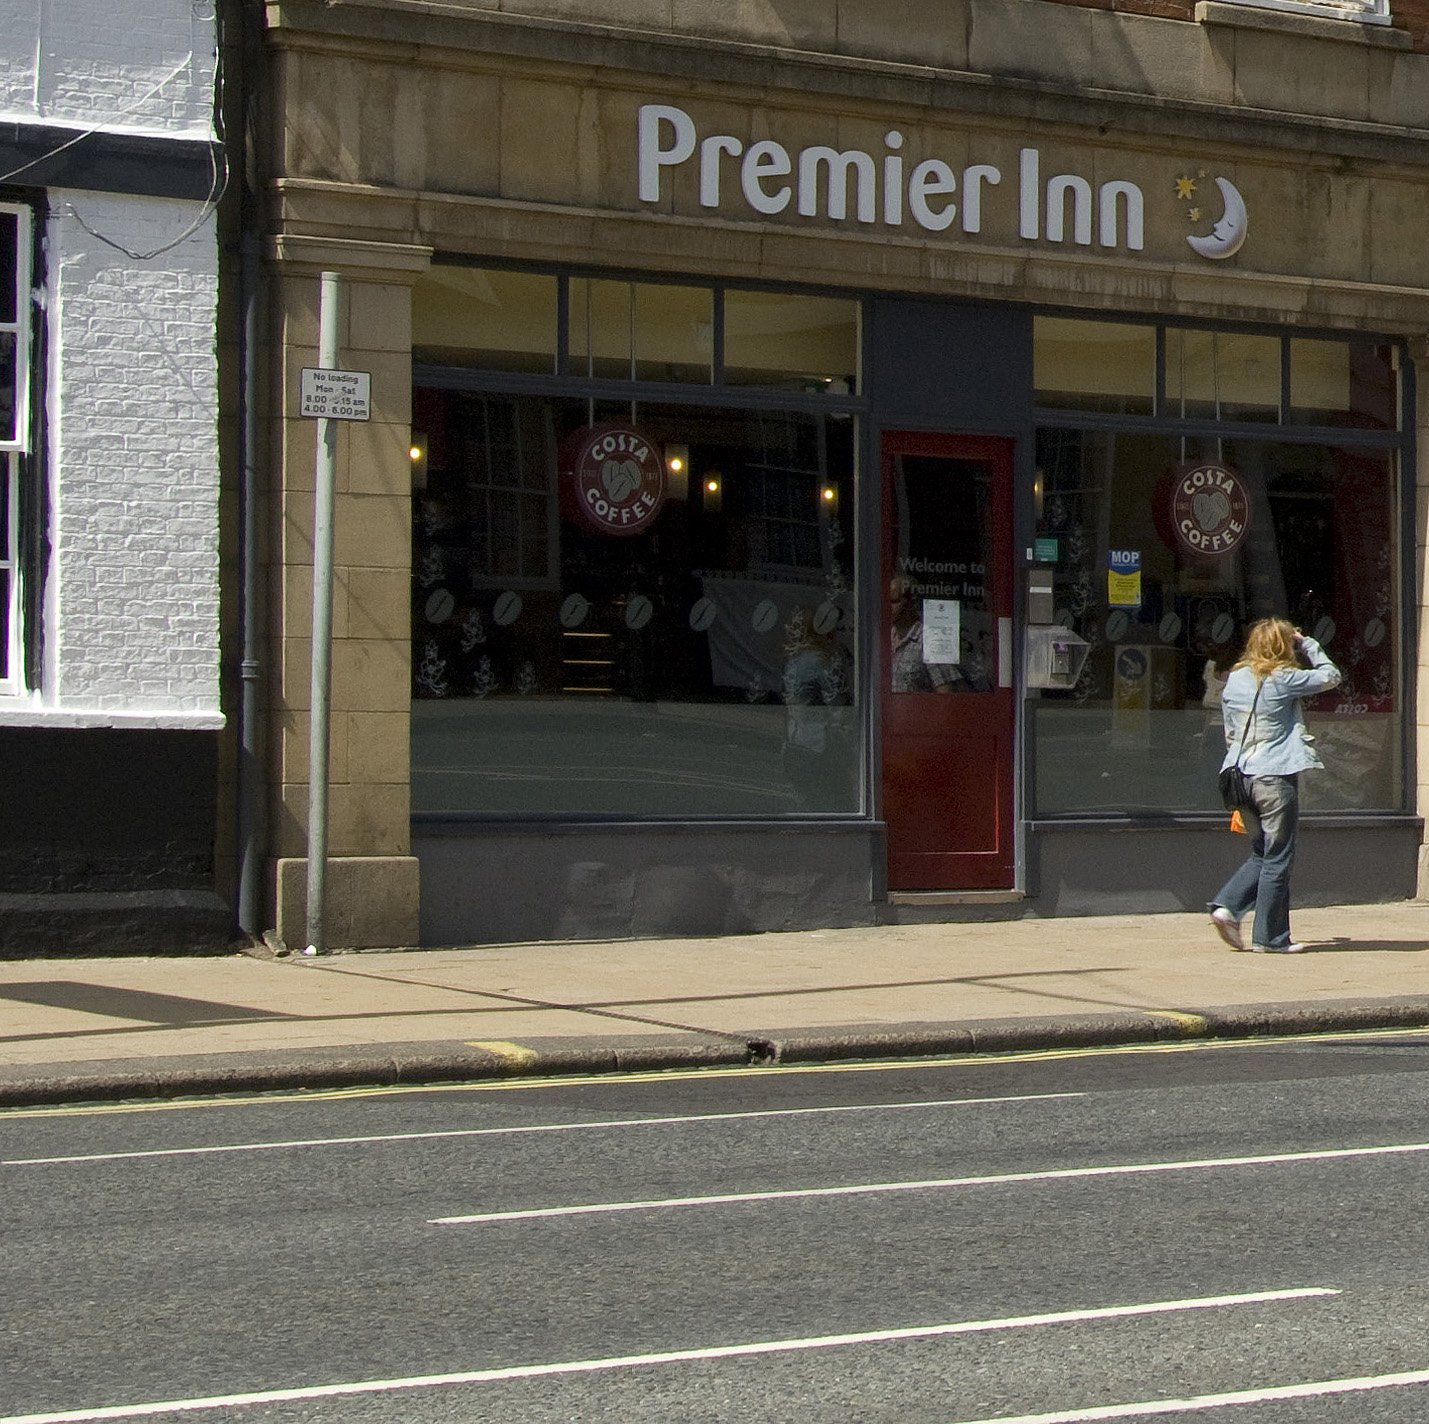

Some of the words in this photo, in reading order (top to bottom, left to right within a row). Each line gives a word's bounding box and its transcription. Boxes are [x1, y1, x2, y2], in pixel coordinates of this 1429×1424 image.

[637, 102, 1001, 234] Premier
[1019, 146, 1145, 251] Inn
[313, 372, 326, 381] No
[328, 373, 359, 385] loading
[315, 384, 333, 393] Mon
[341, 386, 357, 395] Sat
[306, 395, 327, 404] 8.00
[334, 397, 351, 405] .15
[354, 409, 367, 417] pm
[592, 435, 649, 463] COSTA
[1183, 469, 1234, 494] COSTA
[587, 488, 655, 524] COFFEE
[1181, 519, 1242, 550] COFFEE
[899, 557, 967, 573] Welcome
[970, 562, 985, 574] to
[1111, 551, 1139, 563] MOP
[901, 579, 960, 595] Premier
[963, 582, 985, 596] Inn
